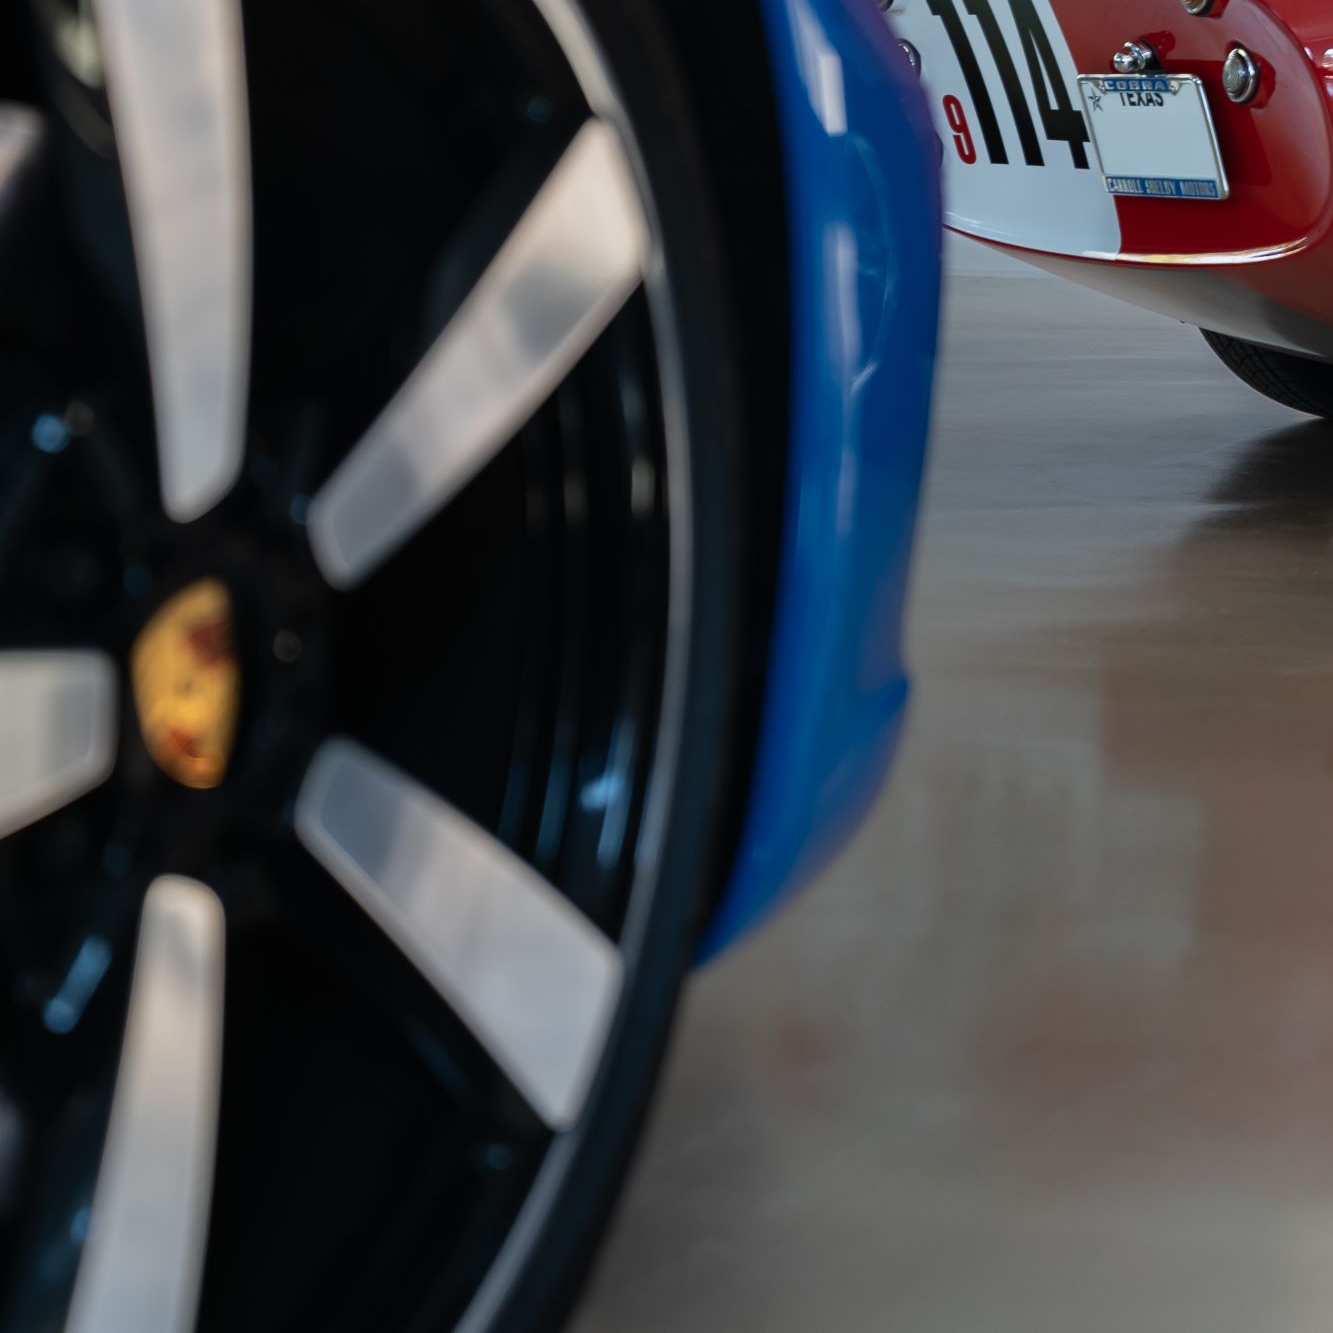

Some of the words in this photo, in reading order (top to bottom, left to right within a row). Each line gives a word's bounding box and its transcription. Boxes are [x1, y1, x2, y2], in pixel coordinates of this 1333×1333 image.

[1104, 79, 1166, 91] COBRA
[1119, 92, 1164, 107] TEXAS
[943, 94, 976, 164] 9
[1107, 177, 1144, 193] CARROLL
